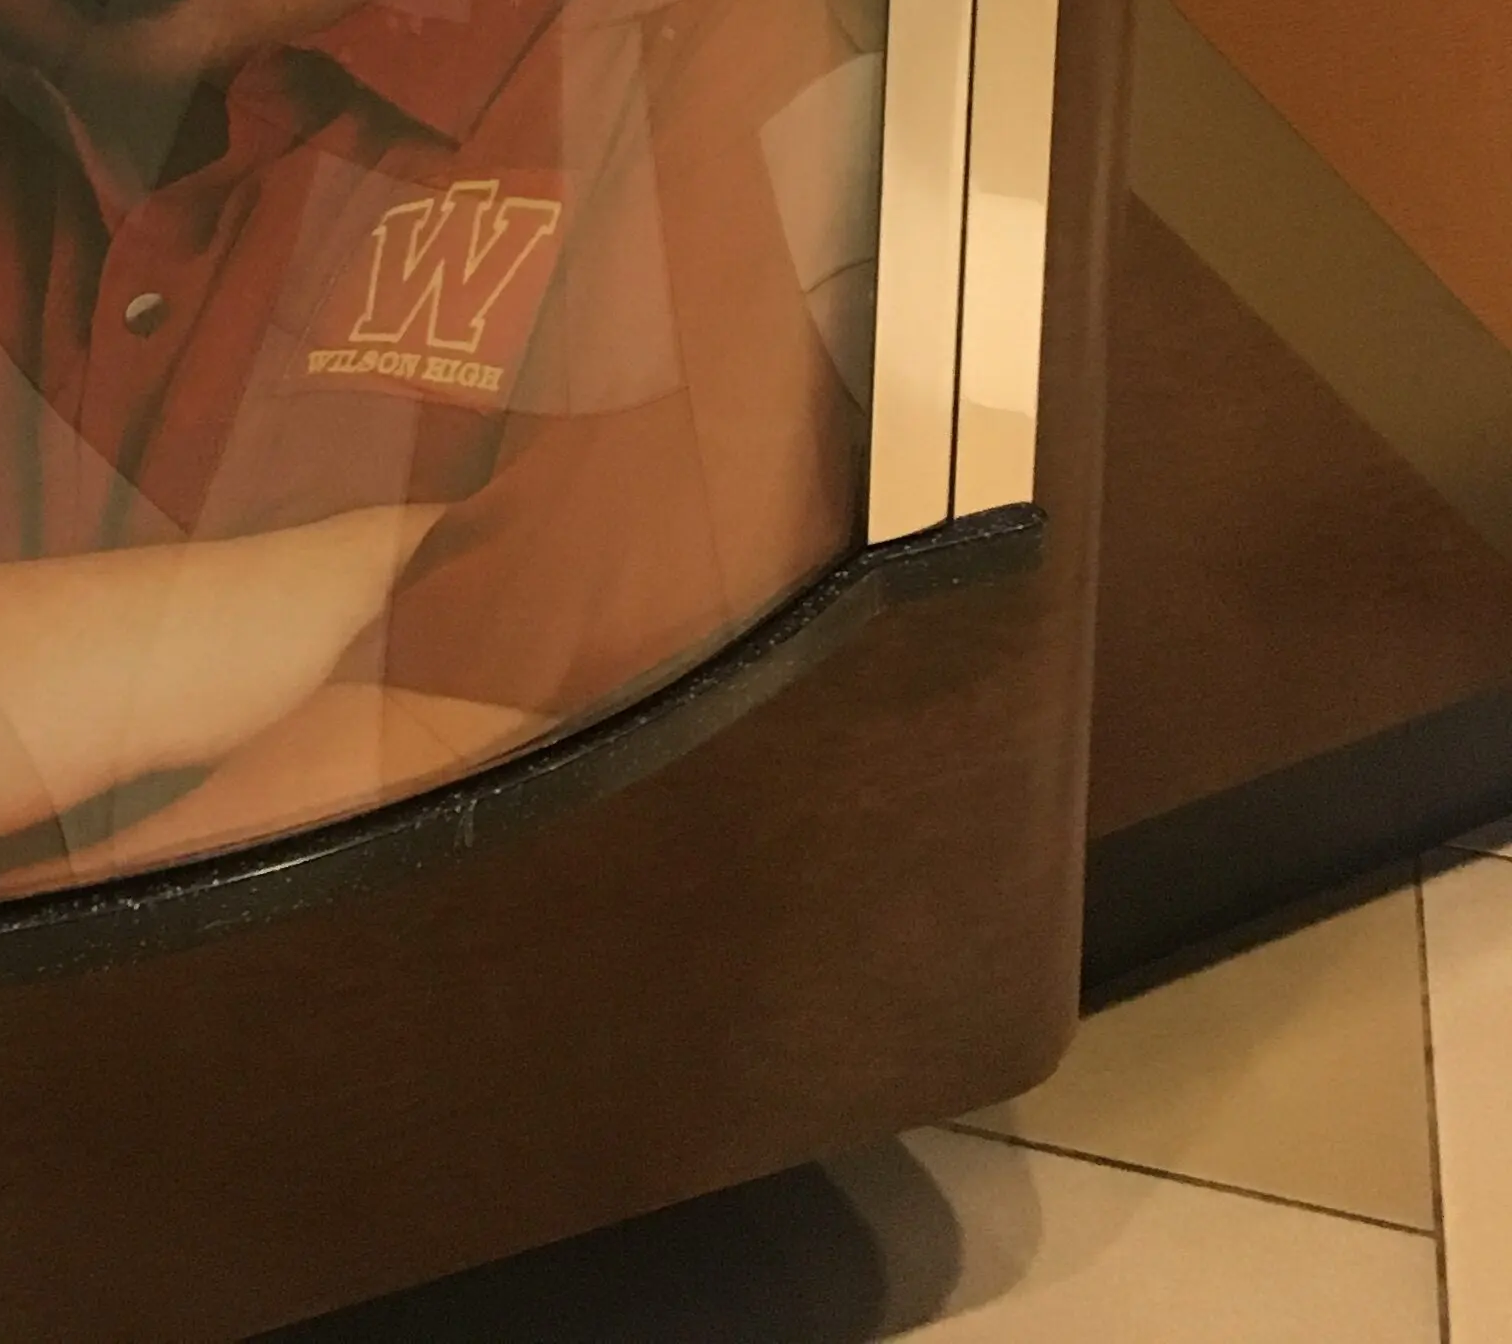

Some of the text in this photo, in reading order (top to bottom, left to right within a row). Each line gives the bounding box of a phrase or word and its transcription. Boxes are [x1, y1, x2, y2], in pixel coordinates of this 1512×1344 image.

[348, 179, 562, 353] W
[306, 349, 505, 392] WILSON HIGH
